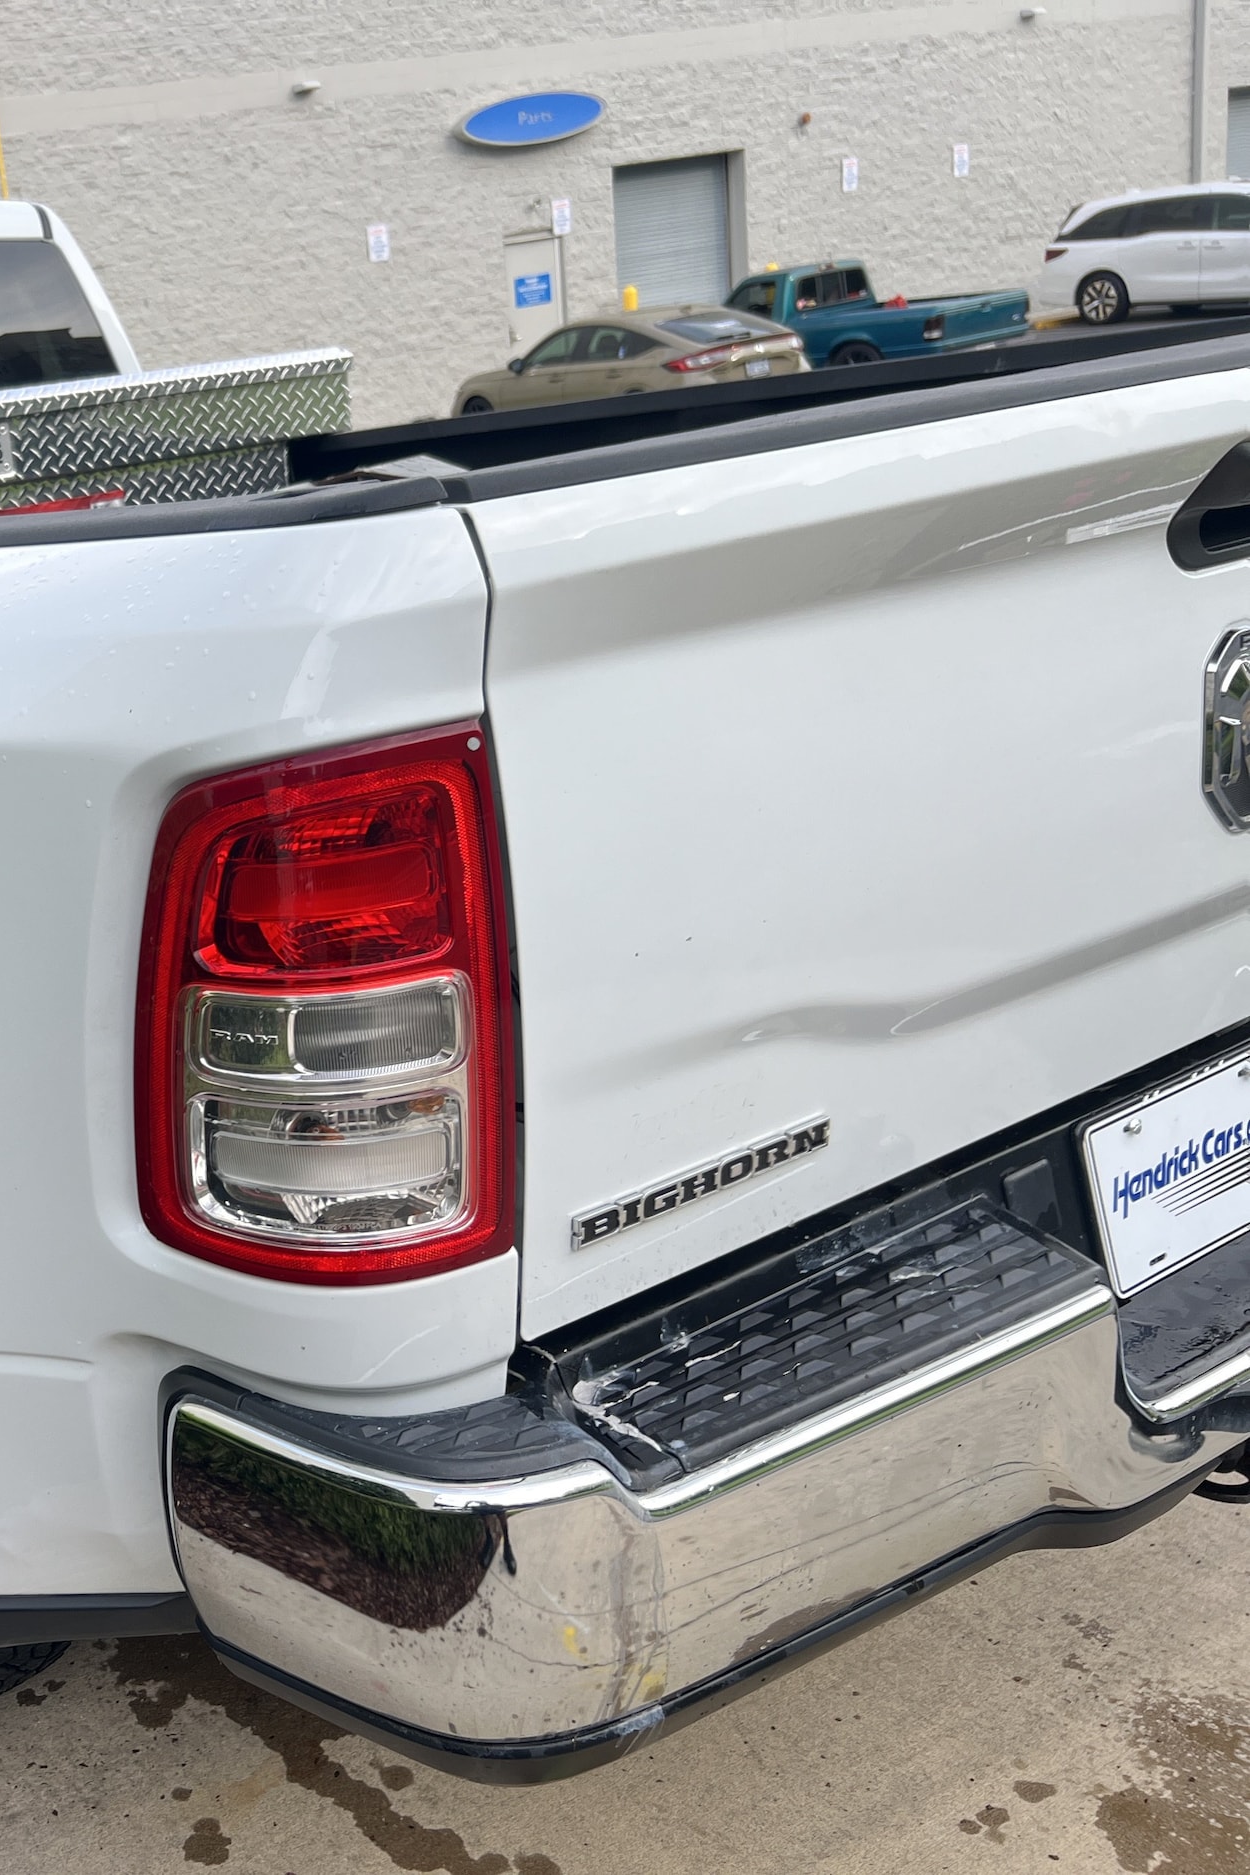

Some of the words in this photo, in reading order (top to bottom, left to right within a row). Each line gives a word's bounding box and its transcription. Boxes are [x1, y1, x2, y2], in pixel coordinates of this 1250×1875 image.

[517, 110, 553, 126] Parts
[209, 1028, 279, 1046] RAM
[573, 1116, 830, 1248] BIGHORN
[1112, 1138, 1200, 1220] Hendrick
